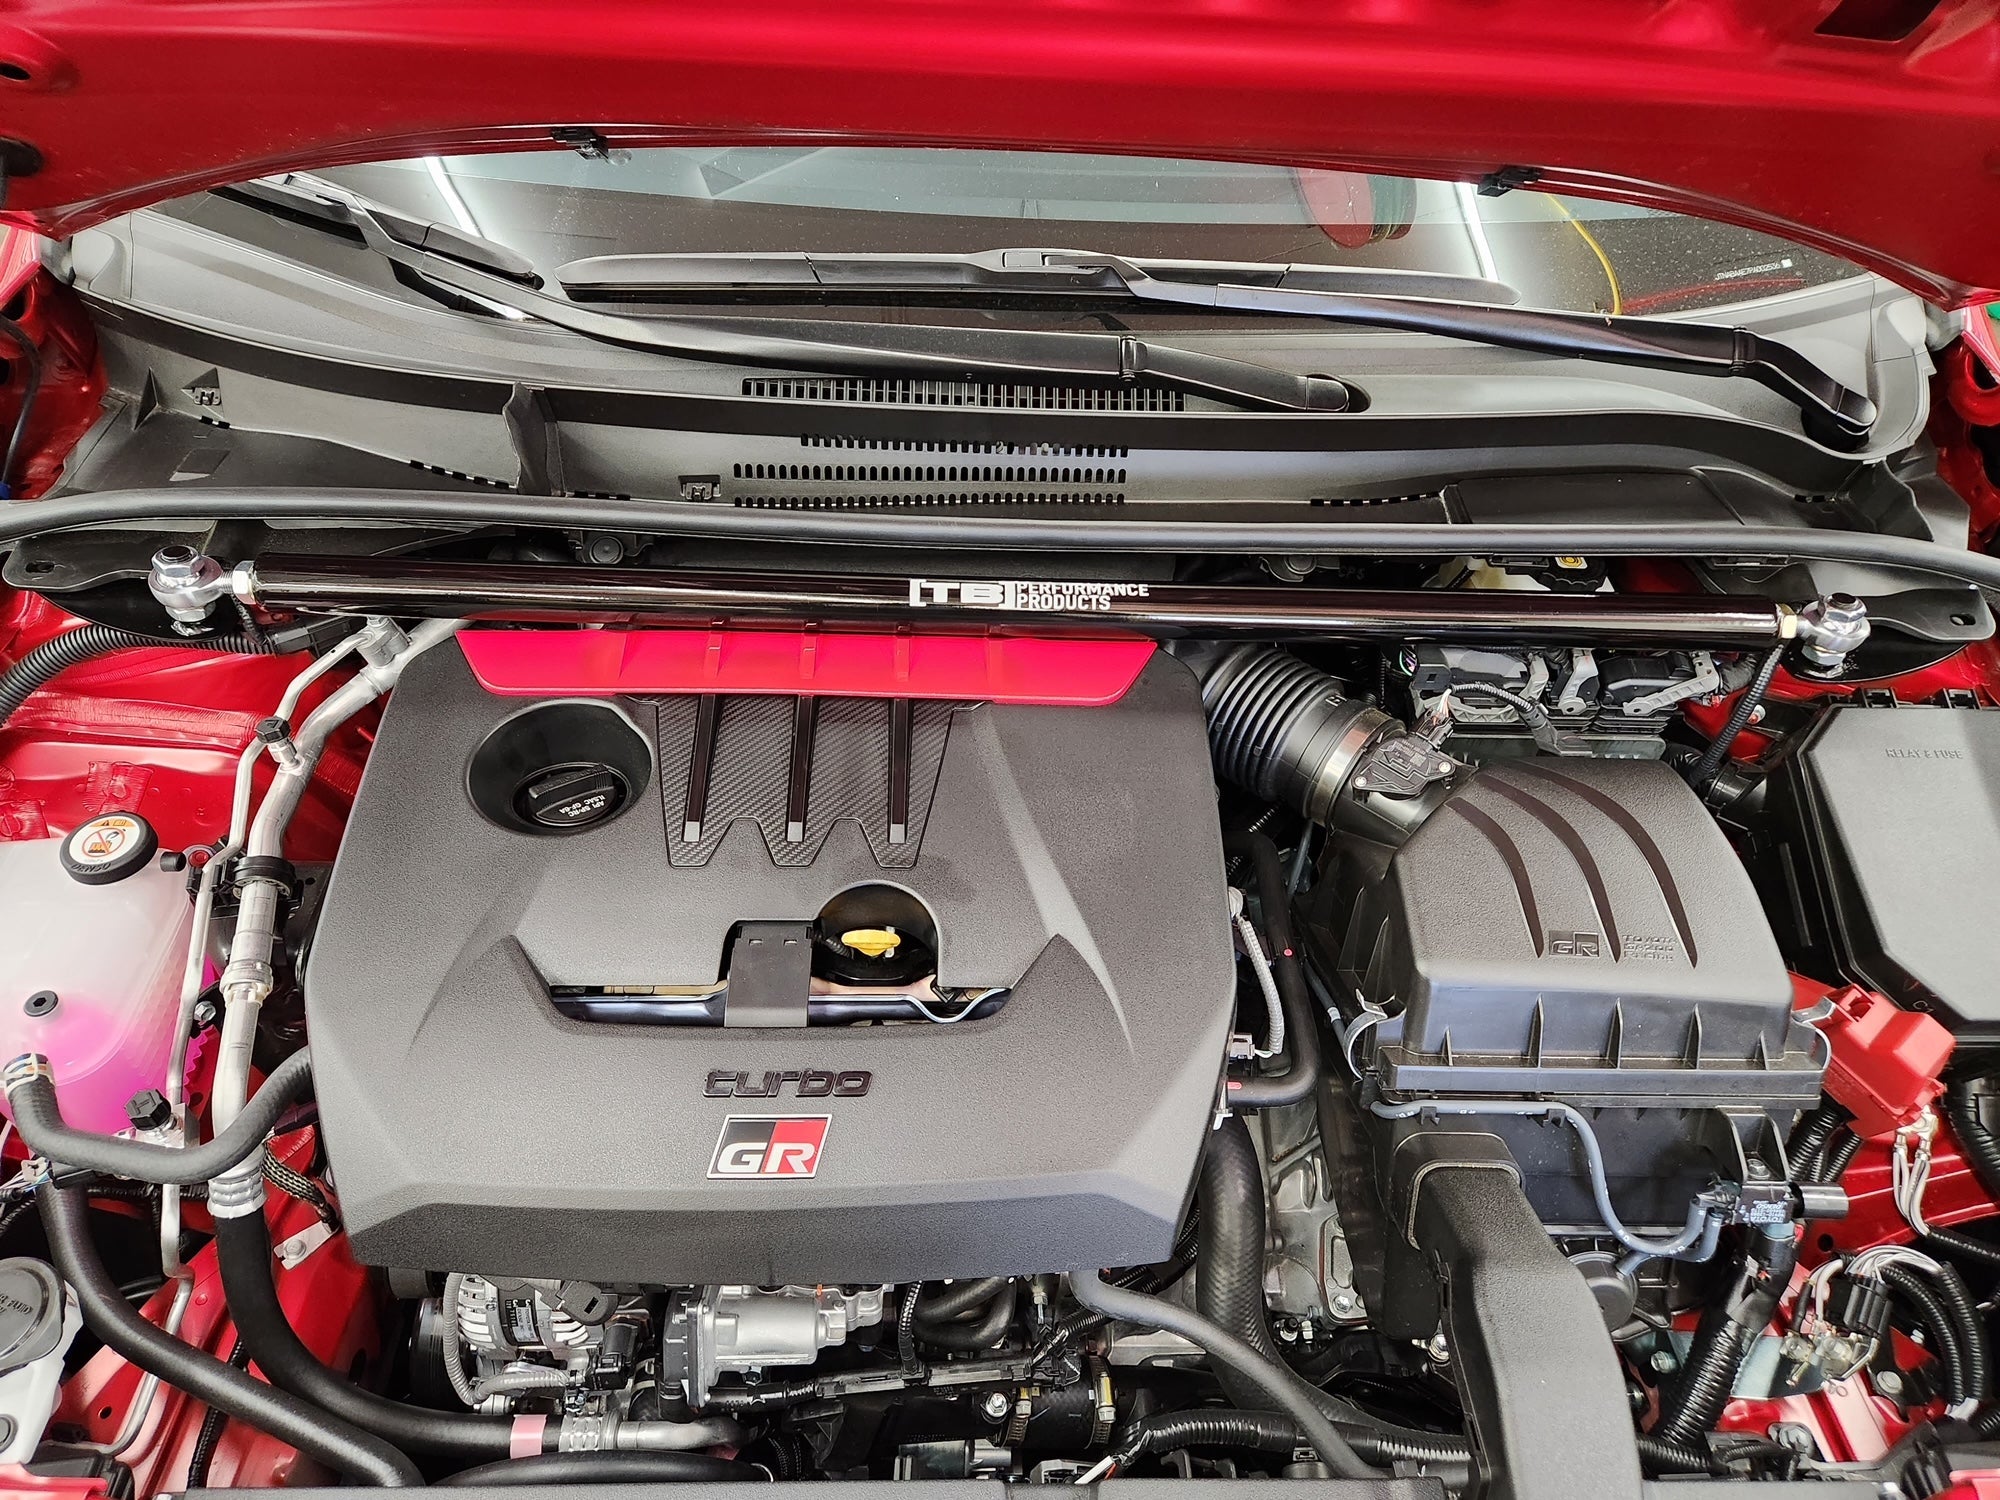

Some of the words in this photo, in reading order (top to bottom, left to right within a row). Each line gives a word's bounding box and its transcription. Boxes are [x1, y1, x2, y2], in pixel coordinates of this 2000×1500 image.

[1016, 582, 1150, 597] PERFORMANCE
[1016, 593, 1112, 611] PRODUCTS
[1885, 748, 1921, 758] RELAY
[1933, 750, 1963, 759] FUSE
[583, 793, 606, 805] ILSAC
[591, 800, 605, 808] API
[558, 802, 582, 814] GF-6A
[567, 805, 590, 817] SP/RC
[71, 862, 112, 873] DENSO
[1622, 934, 1676, 944] TOYOTA
[1551, 940, 1599, 957] GR
[702, 1068, 873, 1098] turbo
[717, 1143, 816, 1173] GR
